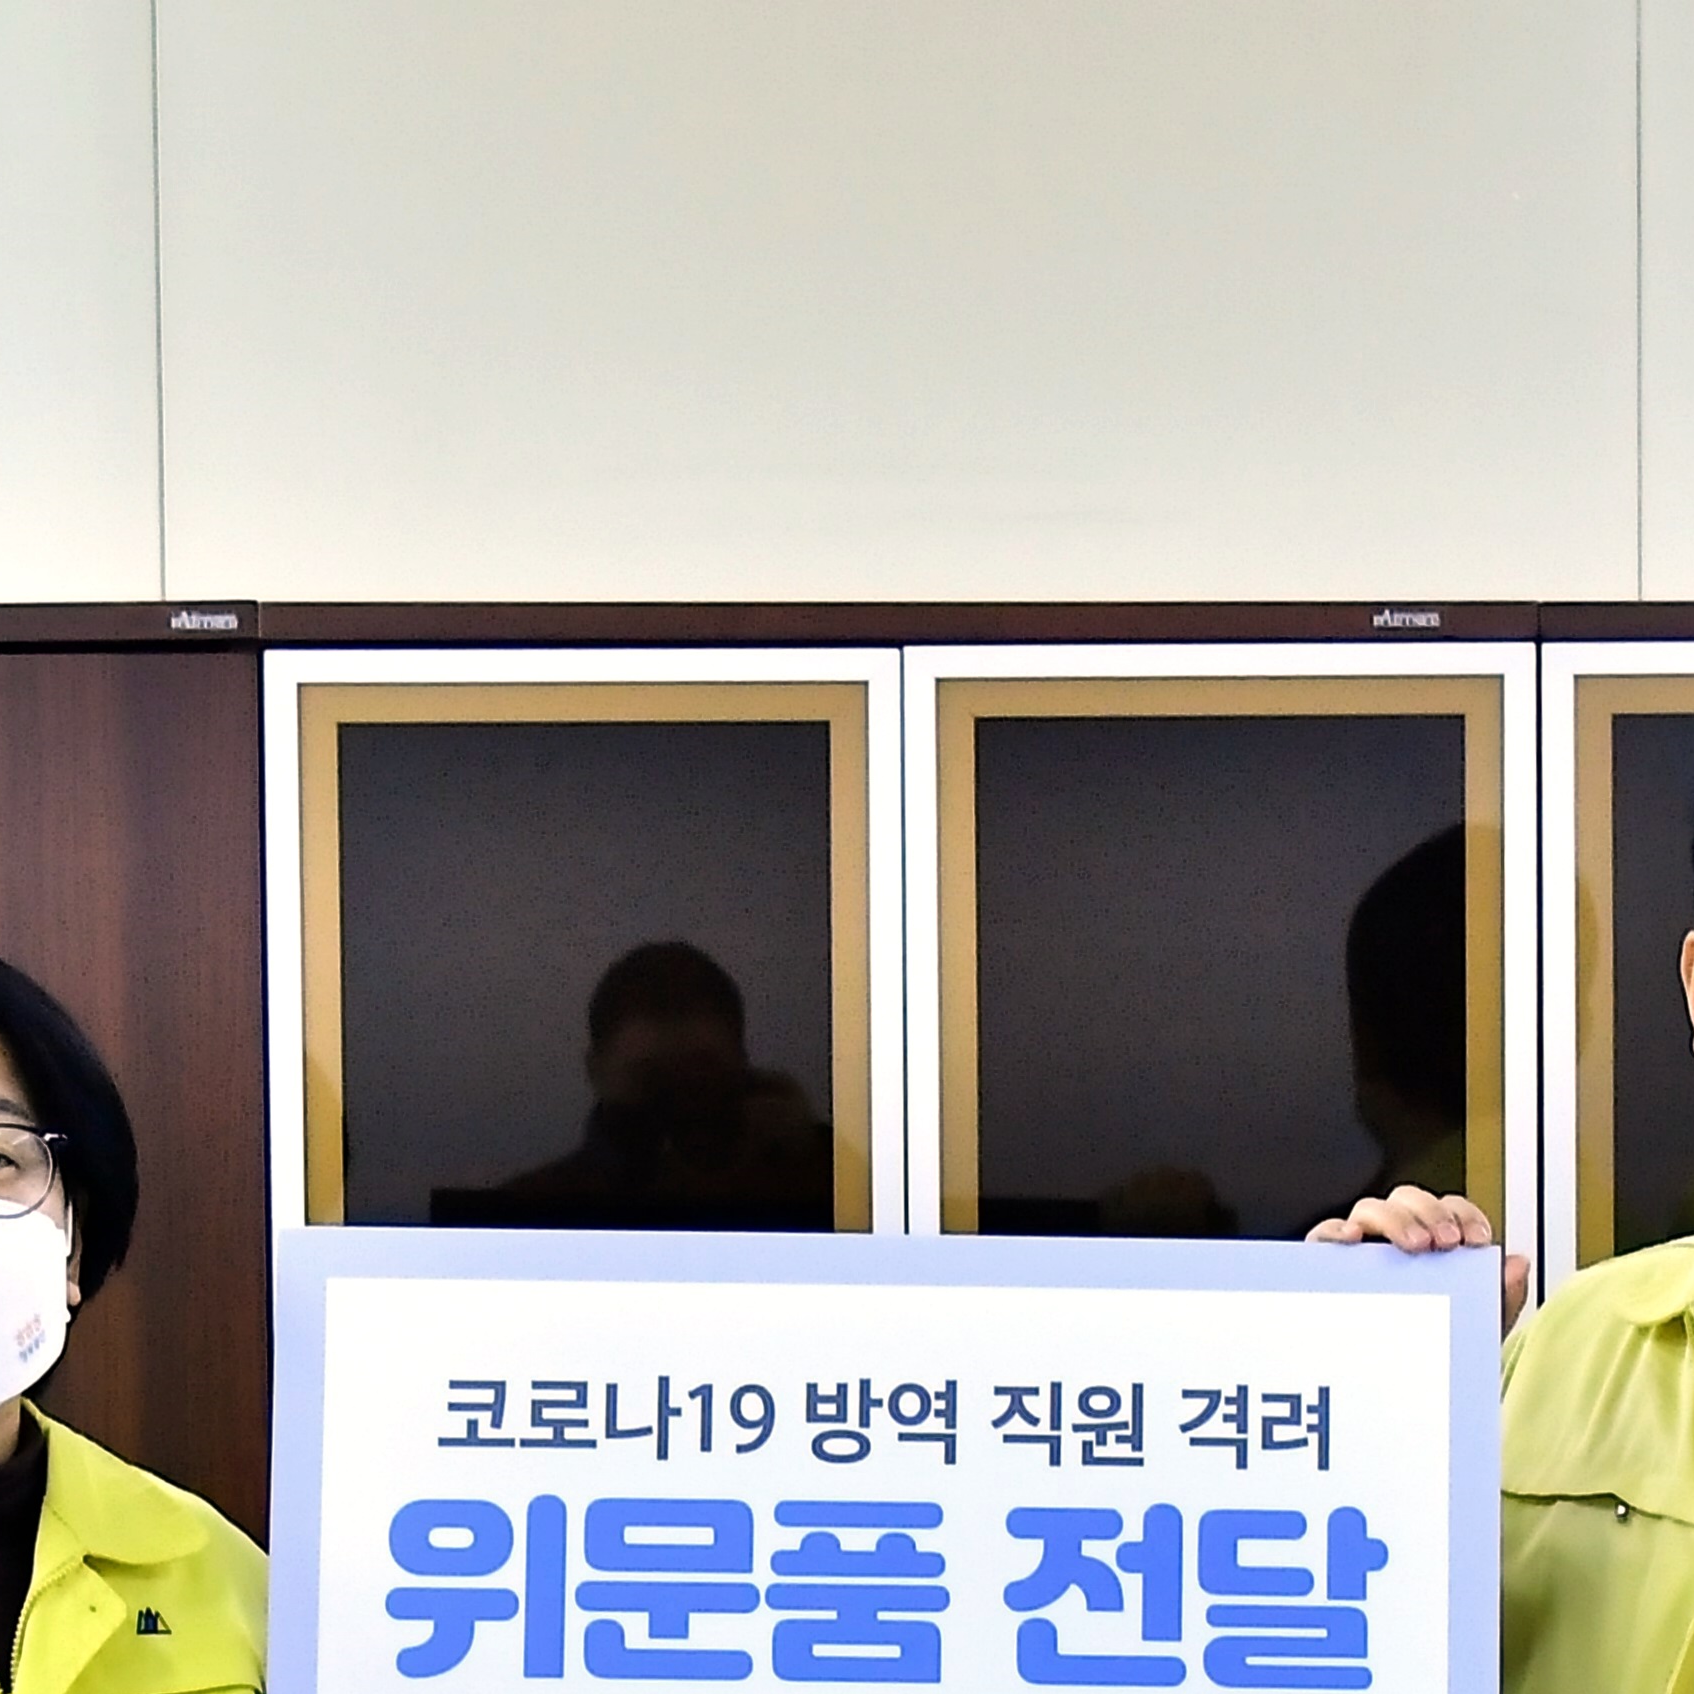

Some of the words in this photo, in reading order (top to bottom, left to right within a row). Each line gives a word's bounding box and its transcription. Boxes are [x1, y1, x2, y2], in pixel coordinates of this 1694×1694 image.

[438, 1376, 776, 1462] 코로나19
[805, 1378, 958, 1466] 방역
[991, 1381, 1145, 1468] 직원
[1179, 1384, 1331, 1472] 격려
[385, 1496, 950, 1684] 위문품
[1004, 1504, 1389, 1690] 전달
